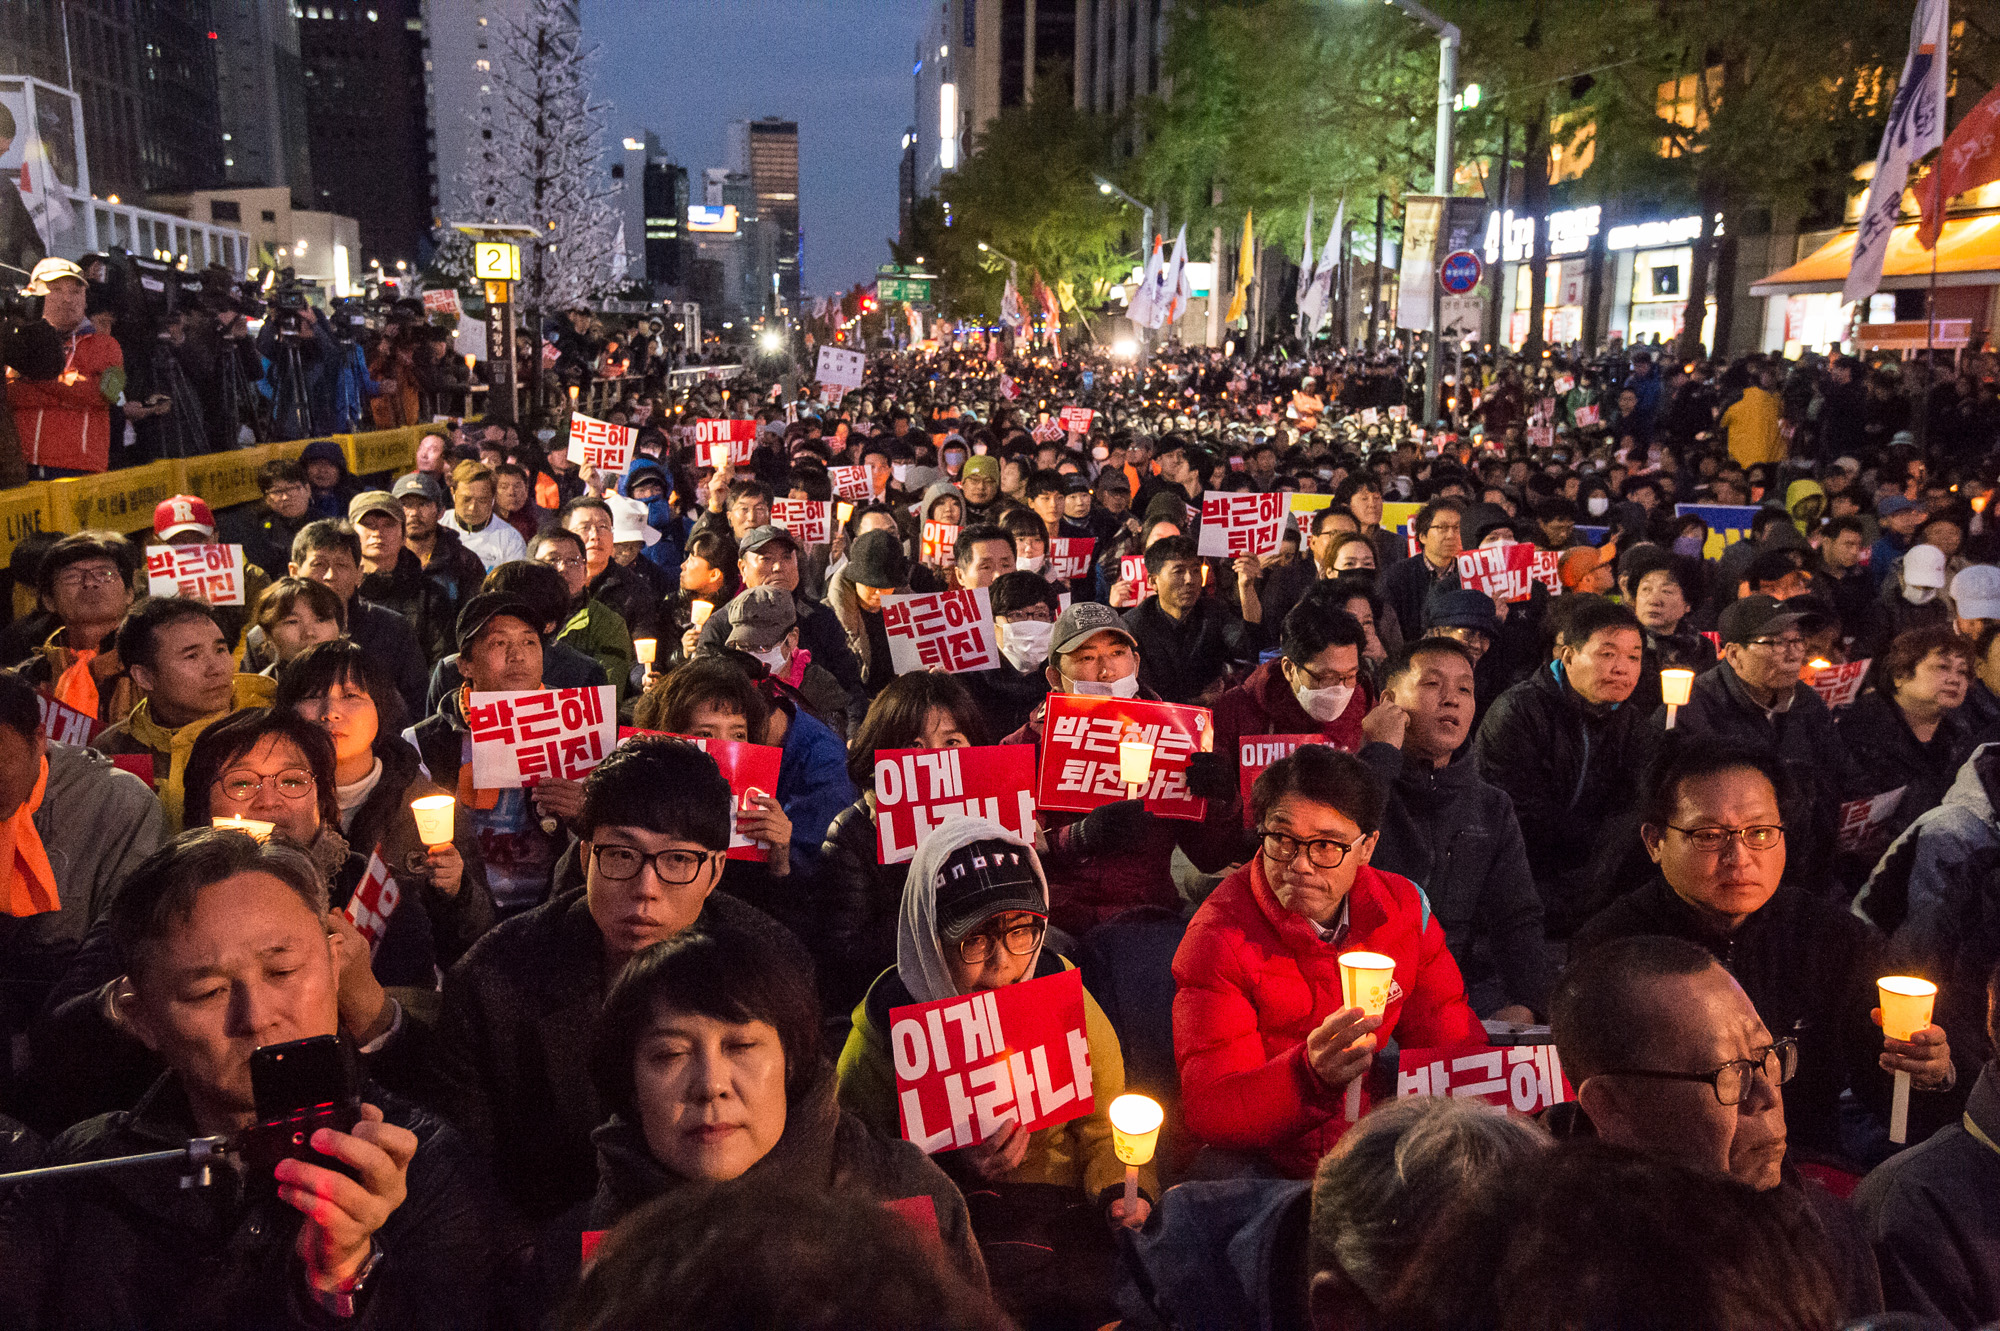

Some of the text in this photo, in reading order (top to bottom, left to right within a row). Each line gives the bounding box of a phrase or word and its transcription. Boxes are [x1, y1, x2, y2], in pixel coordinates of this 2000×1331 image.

[487, 249, 502, 272] 2
[571, 419, 629, 447] 박근혜
[696, 419, 731, 442] 이게
[584, 447, 624, 470] 퇴진
[840, 482, 870, 501] 퇴진
[171, 501, 196, 522] R
[771, 500, 825, 522] 박근혜
[1202, 493, 1284, 528] 박근혜
[787, 522, 825, 542] 퇴진
[923, 522, 958, 545] 이게
[1049, 538, 1069, 557] 게
[1227, 523, 1278, 558] 퇴진
[147, 544, 234, 579] 박근혜
[1121, 558, 1145, 581] 이
[1459, 546, 1506, 579] 이게
[177, 572, 237, 603] 퇴진
[882, 589, 981, 639] 박근혜
[916, 626, 989, 671] 퇴진
[1814, 661, 1863, 688] 근혜
[470, 686, 603, 745] 박근혜
[1052, 715, 1192, 761] 박근혜는
[515, 731, 604, 788] 퇴진
[875, 749, 964, 806] 이게
[890, 991, 1006, 1082] 이게
[901, 1027, 1093, 1156] 나라냐
[1397, 1044, 1564, 1116] 박근혜
